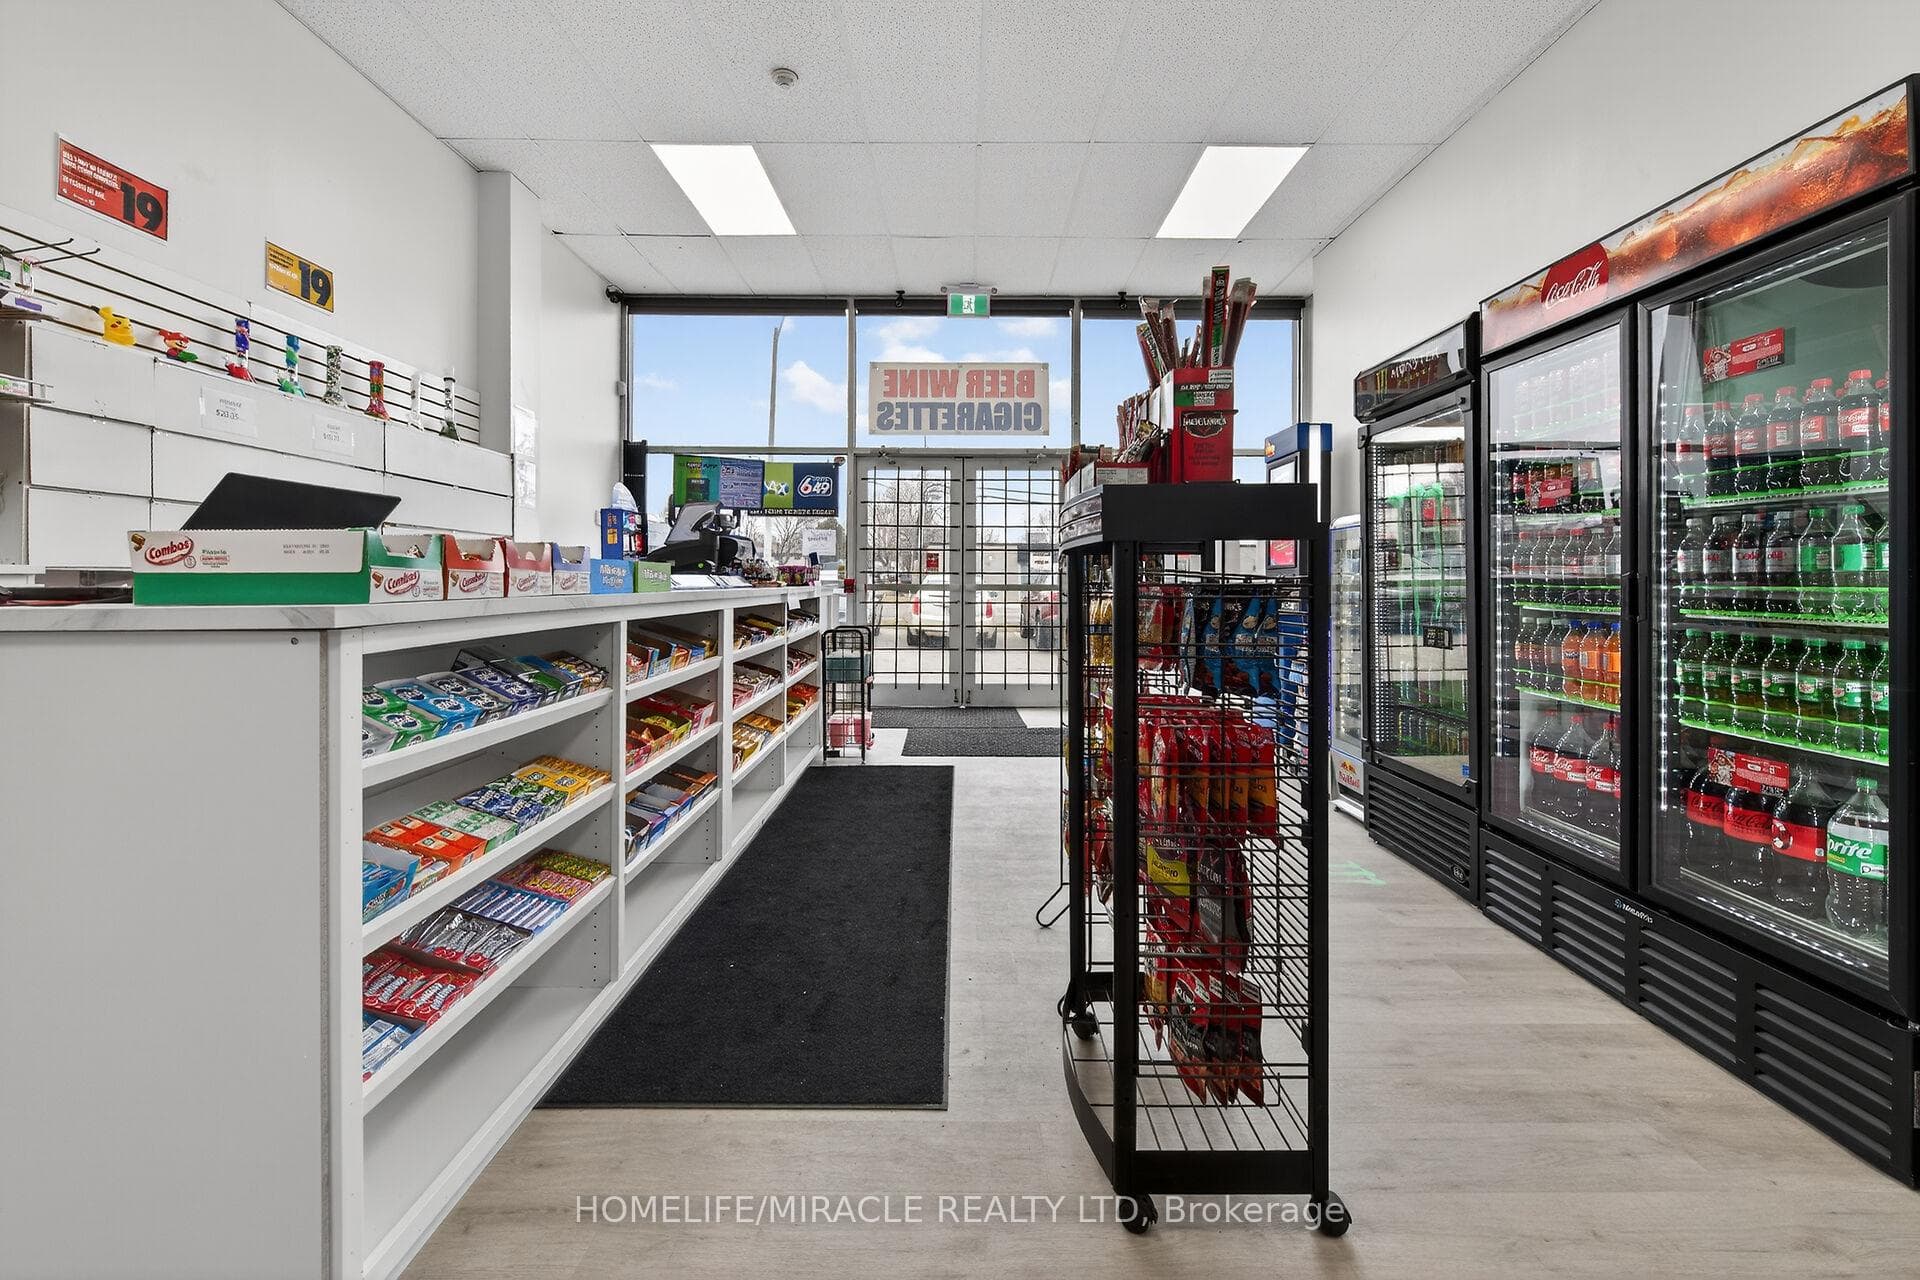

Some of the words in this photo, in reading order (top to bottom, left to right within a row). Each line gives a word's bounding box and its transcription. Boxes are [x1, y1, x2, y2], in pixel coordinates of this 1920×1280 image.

[121, 182, 163, 231] 19
[298, 261, 331, 306] 19
[148, 539, 191, 560] Combos
[386, 571, 418, 590] Combos
[1828, 834, 1872, 859] prite
